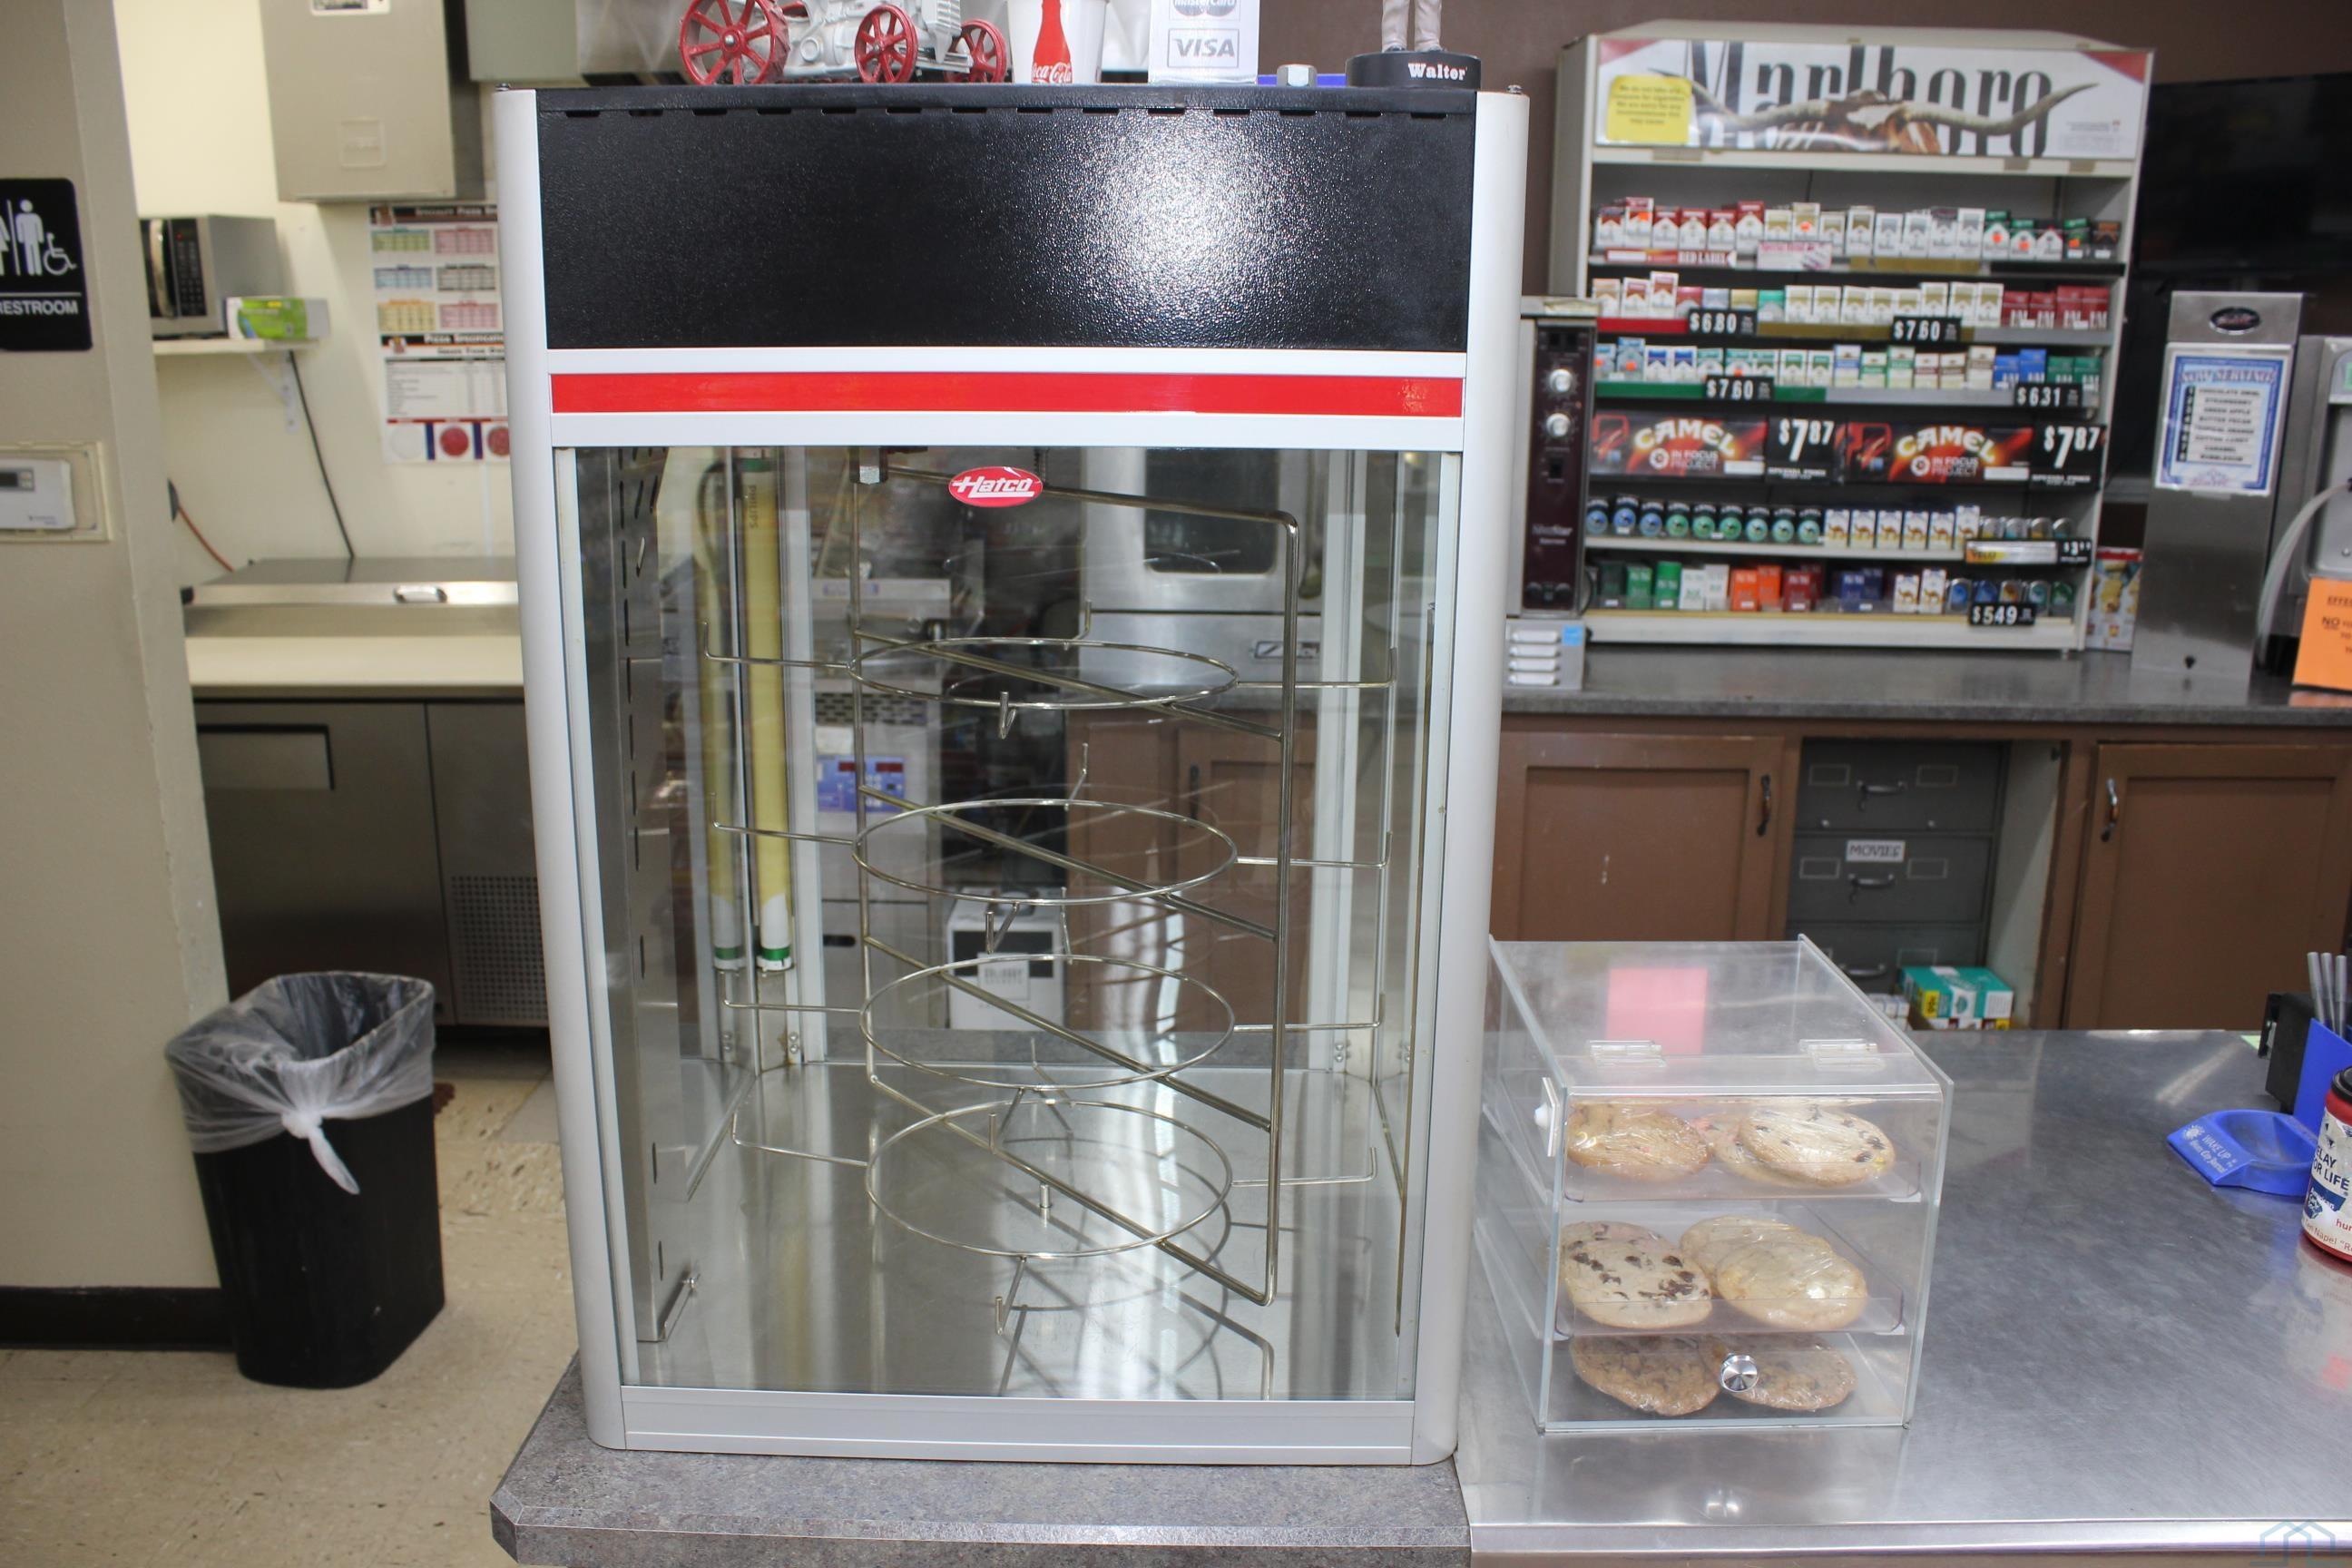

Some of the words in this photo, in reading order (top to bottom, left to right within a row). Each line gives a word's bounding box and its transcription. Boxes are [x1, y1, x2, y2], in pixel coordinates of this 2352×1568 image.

[1173, 38, 1235, 57] VISA
[1408, 63, 1467, 81] Walter
[1634, 418, 1736, 455] CAMEL
[1896, 425, 1996, 463] CAMEL
[952, 476, 1035, 498] Hatco
[2315, 1145, 2337, 1169] ELAY
[2324, 1168, 2350, 1191] LIFE
